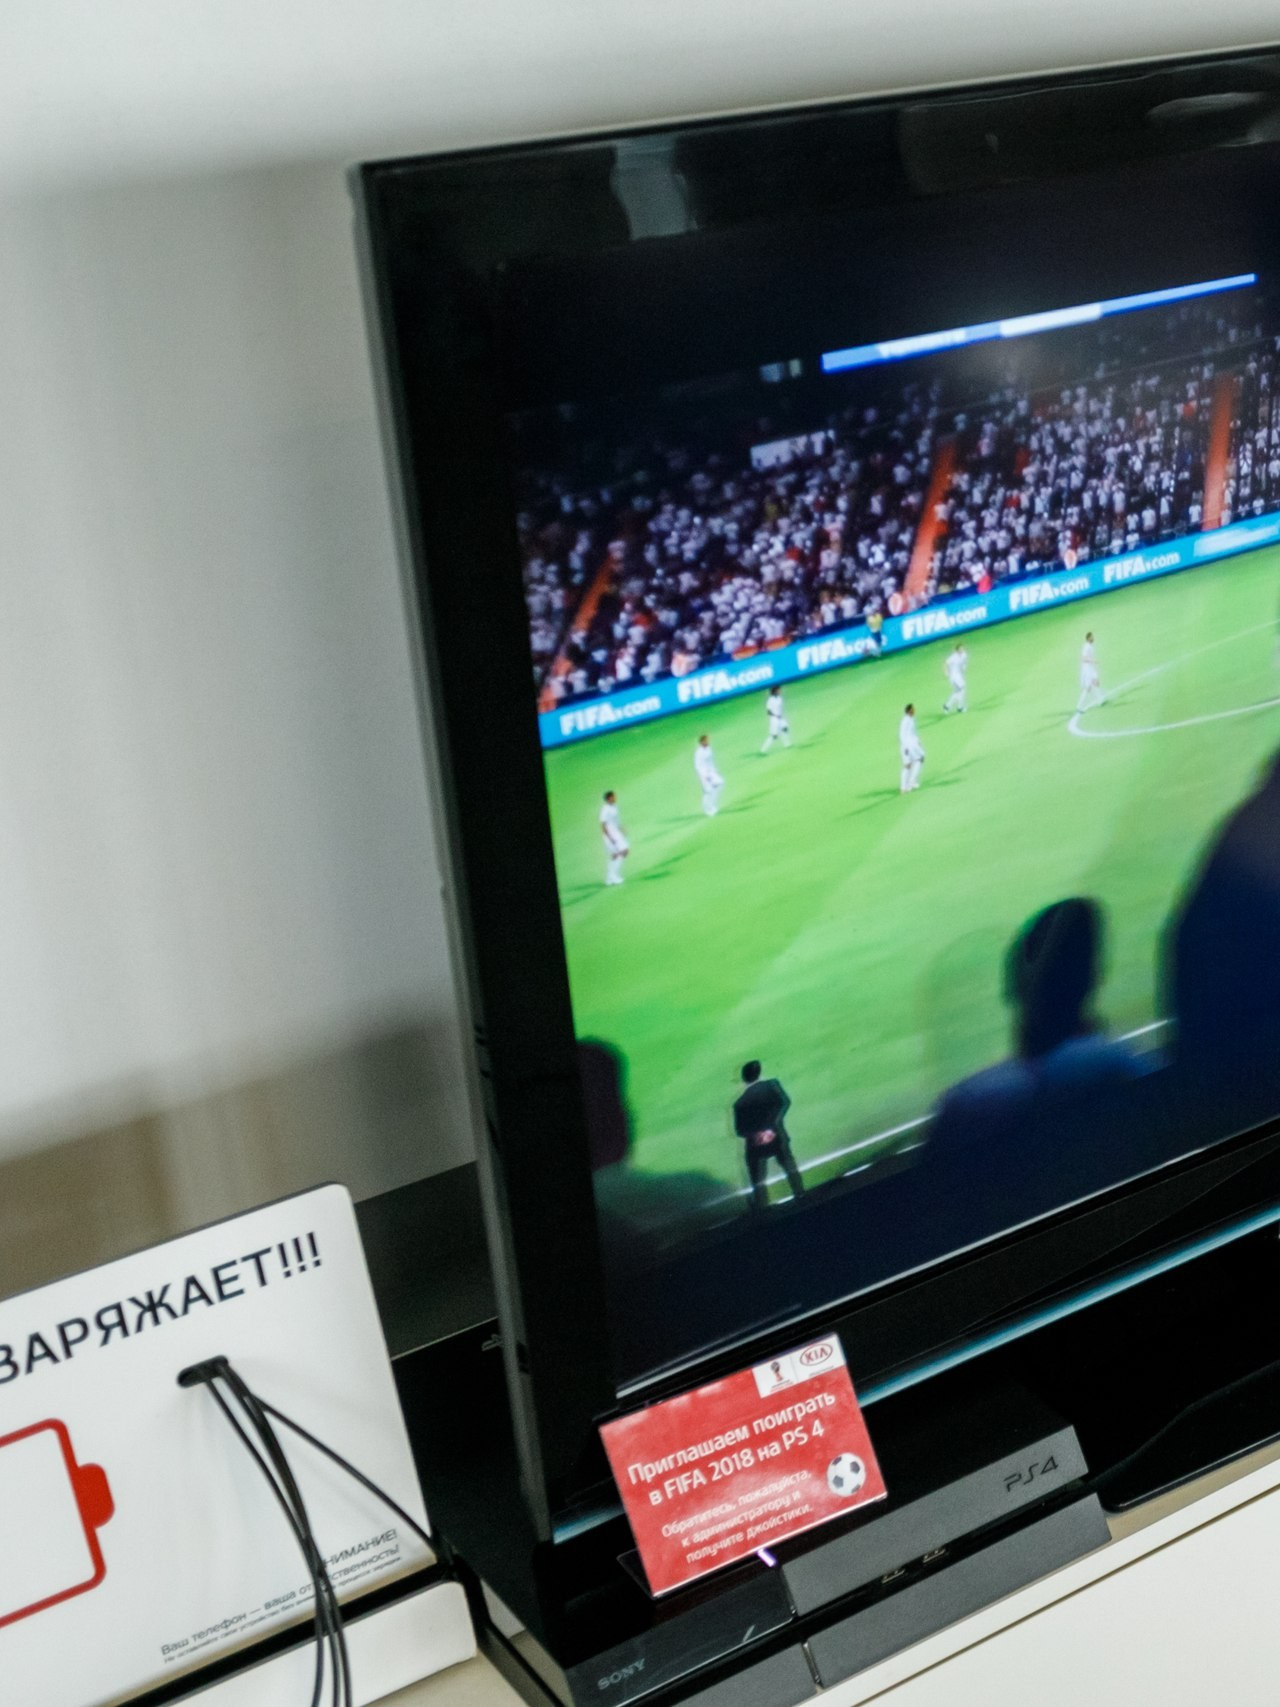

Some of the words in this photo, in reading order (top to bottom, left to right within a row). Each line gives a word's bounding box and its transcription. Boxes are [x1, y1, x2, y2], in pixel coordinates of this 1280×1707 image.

[559, 696, 661, 736] FIFA.com
[677, 663, 774, 703] FIFA.com
[903, 606, 987, 640] FIFA.com
[1009, 577, 1090, 611] FIFA.com
[1103, 552, 1180, 583] FIFA.com
[627, 1424, 750, 1485] Приглашаем
[753, 1391, 836, 1435] поиграть
[649, 1489, 662, 1506] в
[664, 1472, 706, 1499] FIFA
[711, 1450, 755, 1481] 2018
[757, 1442, 781, 1462] на
[783, 1428, 808, 1451] PS
[811, 1419, 825, 1438] 4
[1003, 1455, 1058, 1492] PS4
[692, 1494, 791, 1545] администратору
[325, 1528, 398, 1566] НИМАНИЕ!
[686, 1532, 744, 1563] получите
[161, 1638, 190, 1656] Ваш
[192, 1612, 247, 1642] телефон
[598, 1658, 645, 1690] SONY
